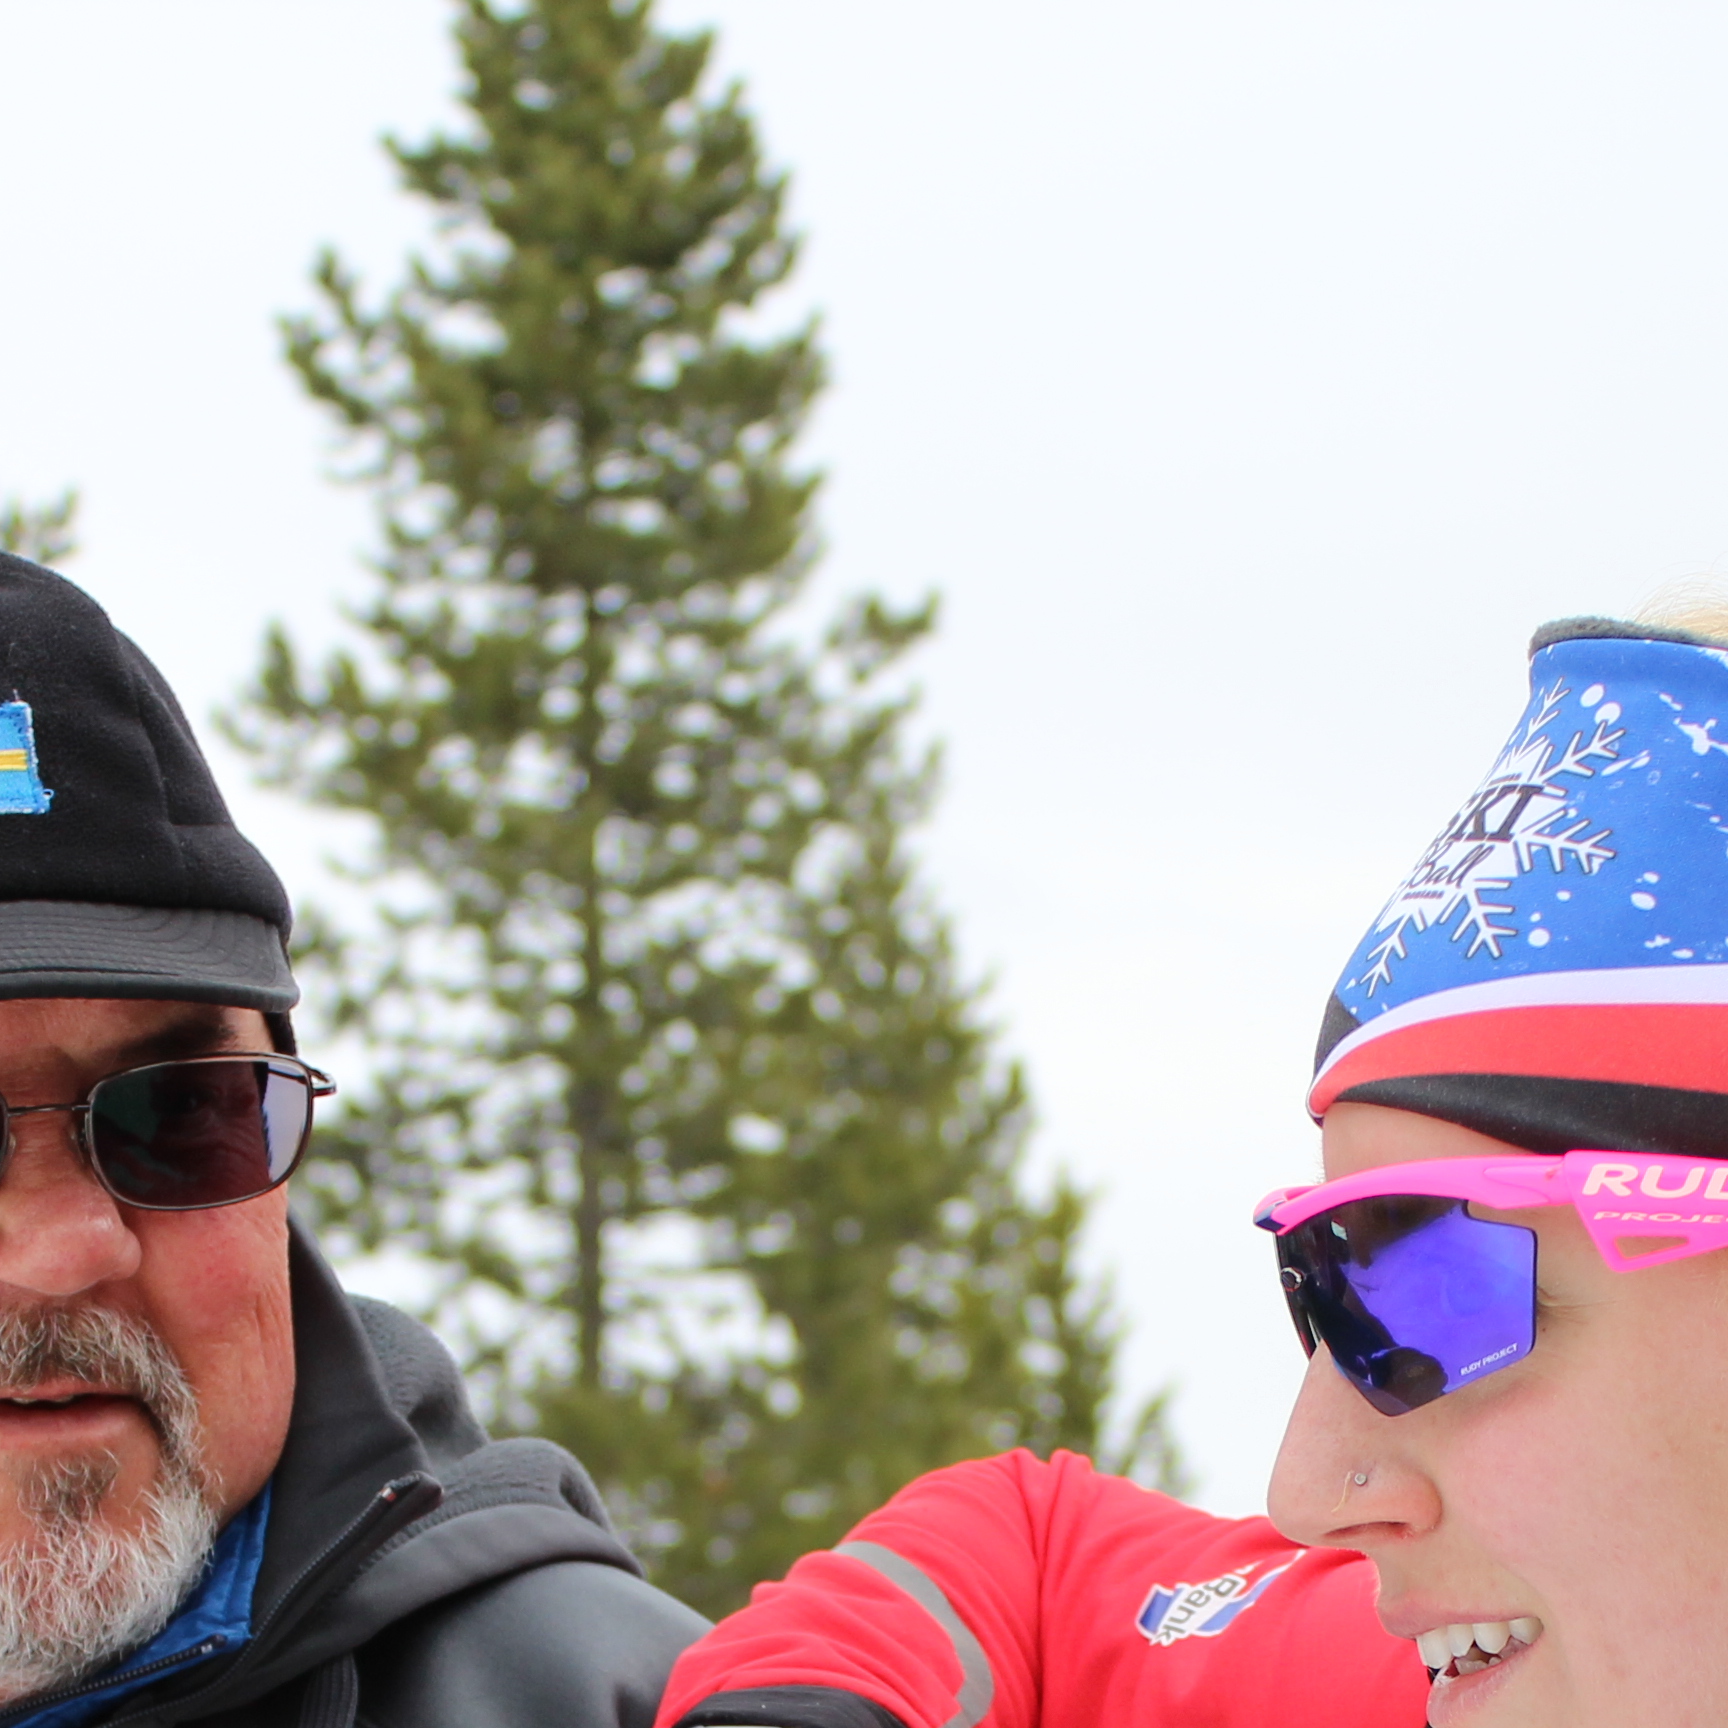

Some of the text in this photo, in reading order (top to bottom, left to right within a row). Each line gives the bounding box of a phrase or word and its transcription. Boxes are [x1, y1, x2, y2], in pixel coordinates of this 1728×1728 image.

[1460, 1342, 1518, 1376] RUDY PROJECT
[1156, 1576, 1240, 1641] Bank
